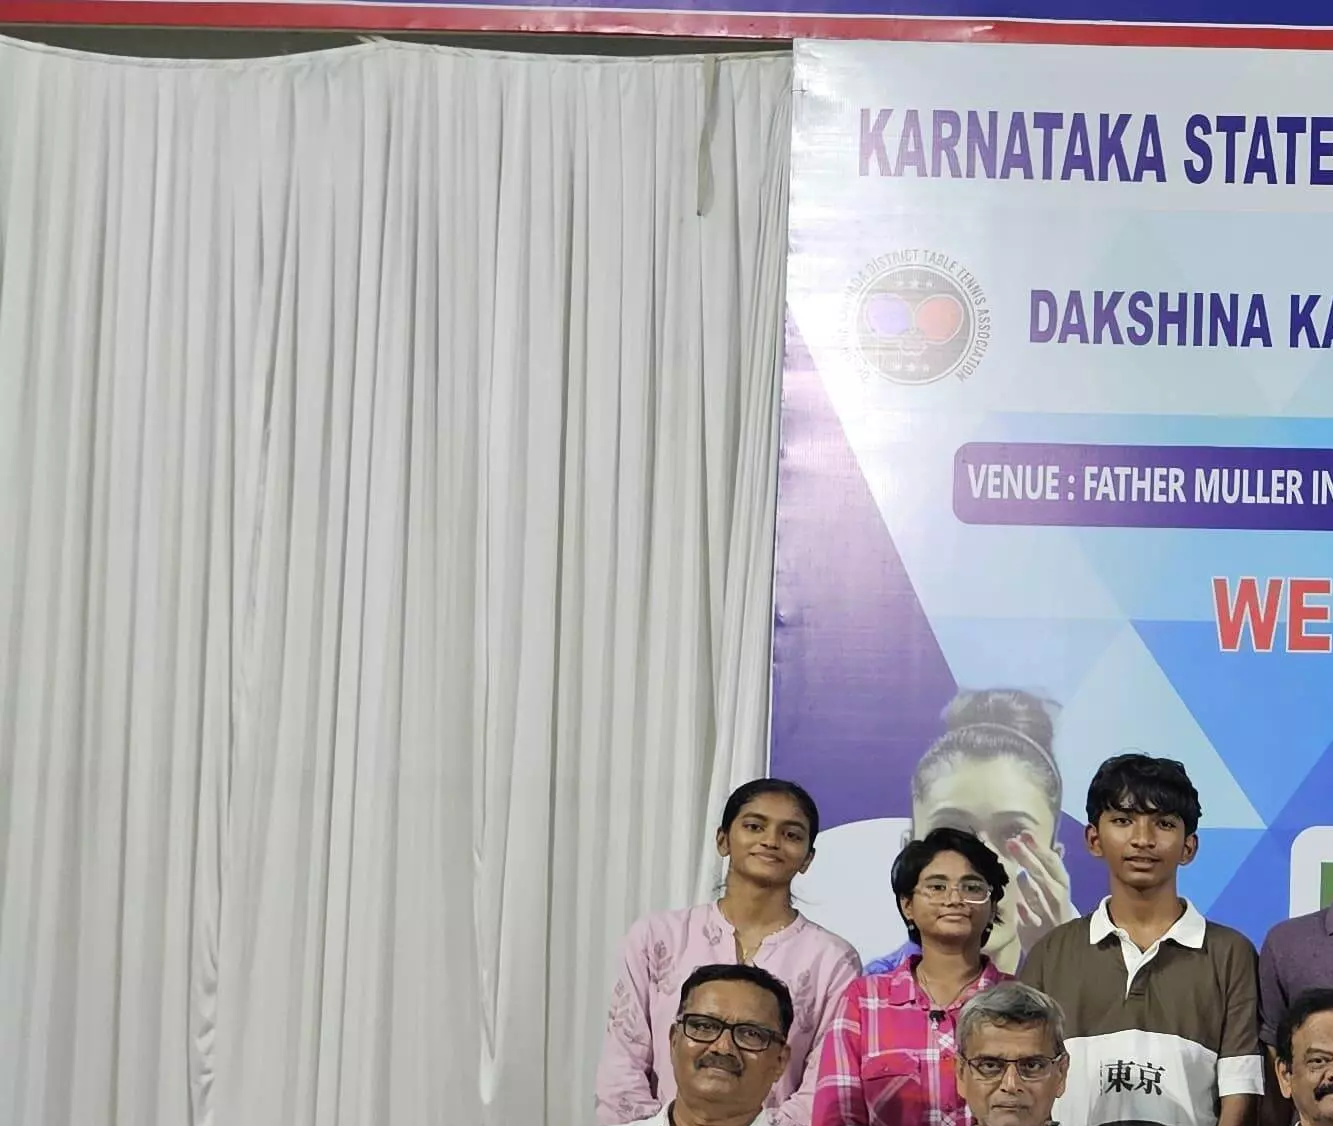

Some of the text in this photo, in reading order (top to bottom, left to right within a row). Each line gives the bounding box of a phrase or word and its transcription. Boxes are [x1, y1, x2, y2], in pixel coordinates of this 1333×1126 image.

[858, 108, 1167, 182] KARNATAKA
[924, 250, 958, 272] TABLE
[957, 267, 986, 305] TENNIS
[1029, 290, 1273, 349] DAKSHINA
[956, 309, 990, 382] ASSOCIATION
[968, 465, 1059, 501] VENUE
[1084, 467, 1186, 503] FATHER
[1195, 469, 1303, 505] MULLER
[1212, 575, 1333, 654] WE
[1104, 1059, 1166, 1095] 東京
